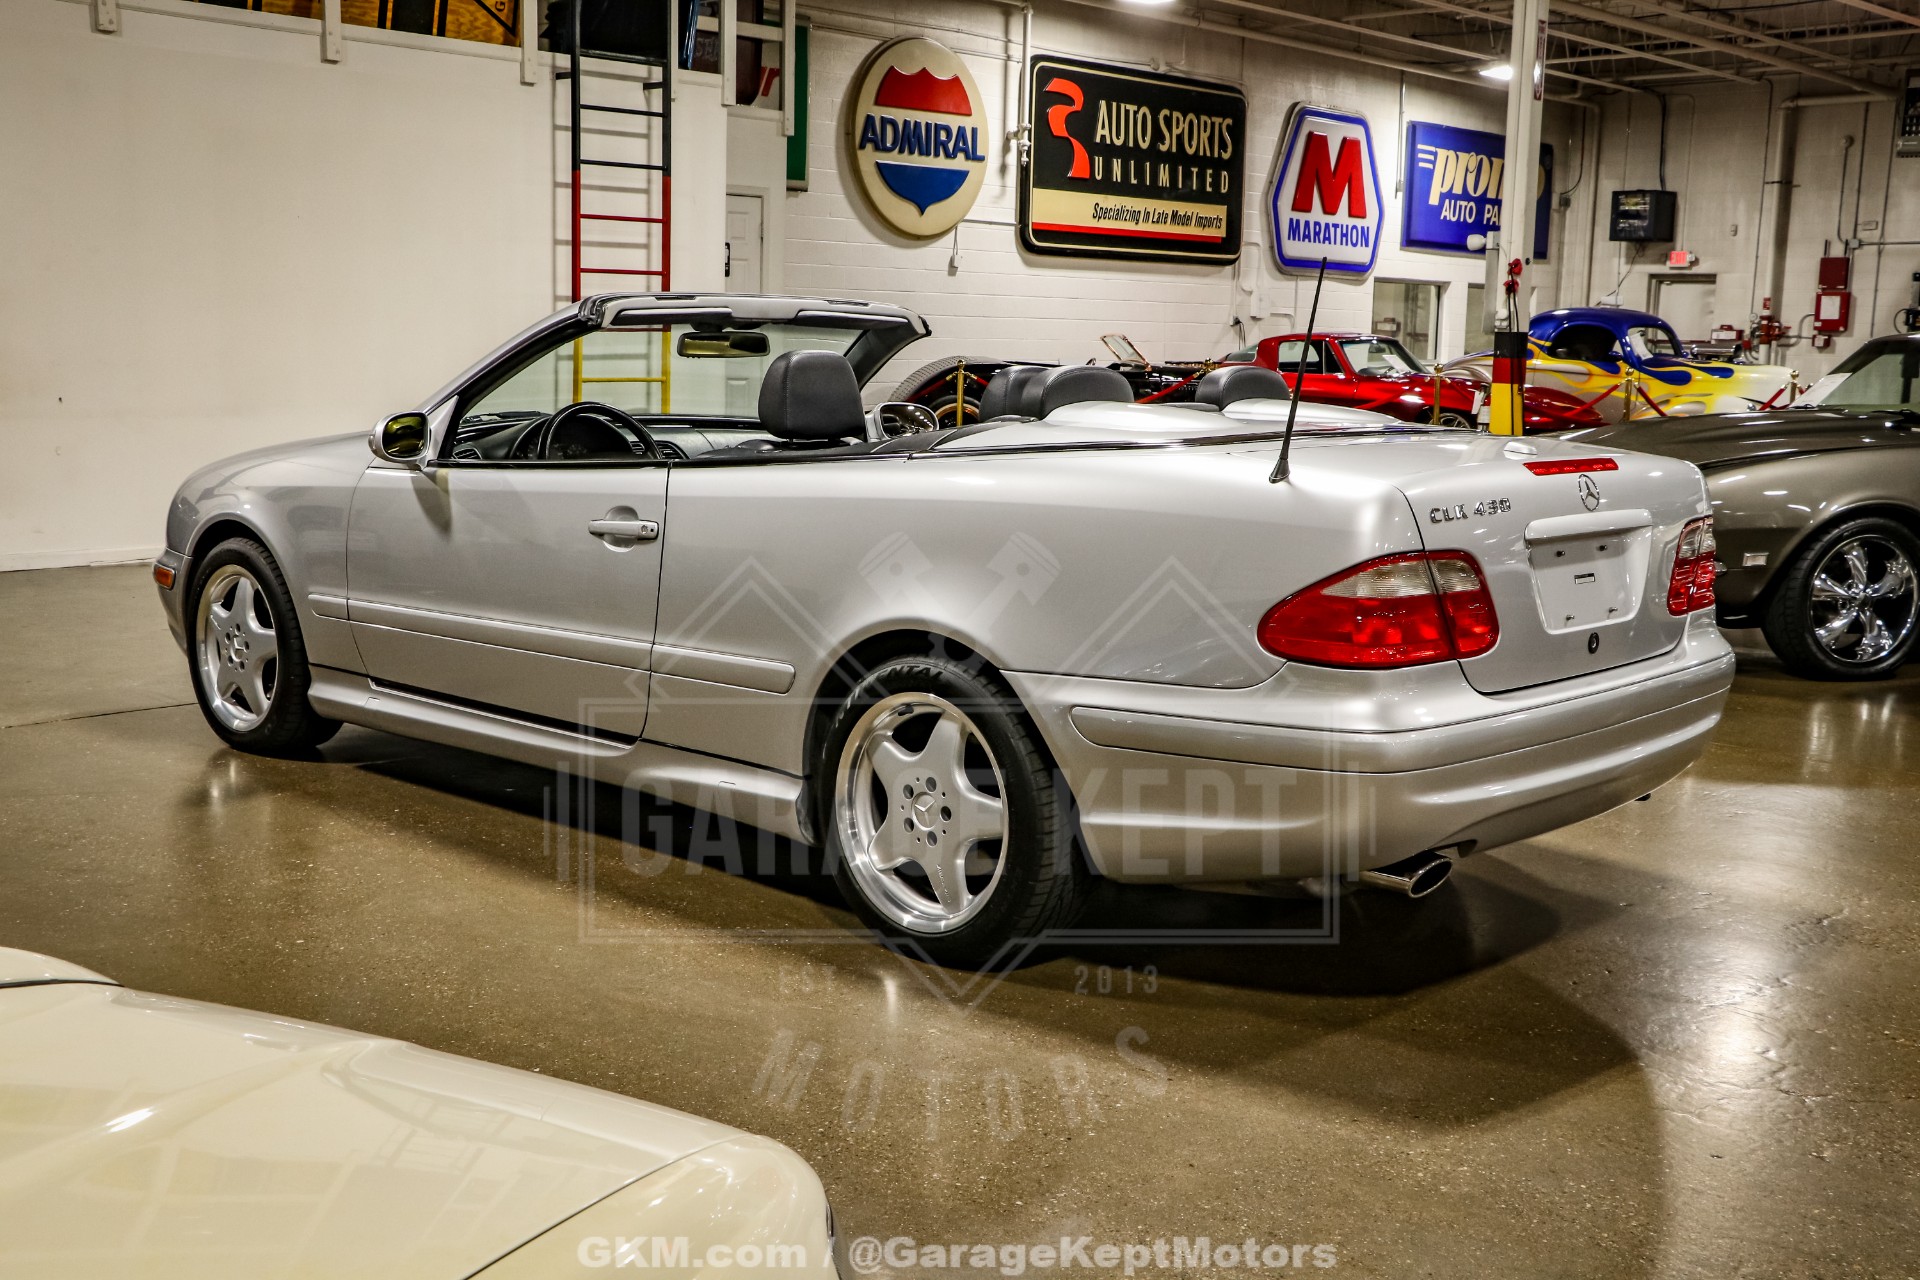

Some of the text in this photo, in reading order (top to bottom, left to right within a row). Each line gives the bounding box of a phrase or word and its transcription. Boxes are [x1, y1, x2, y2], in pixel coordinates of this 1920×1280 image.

[859, 112, 985, 161] ADMIRAL
[1095, 99, 1233, 160] AUTO SPORTS
[1094, 155, 1229, 193] UNLIMITED
[1093, 202, 1223, 231] Specializing In Late Model Imports
[1440, 199, 1477, 223] AUTO
[1287, 217, 1370, 247] MARATHON
[1430, 497, 1511, 524] CLK 430
